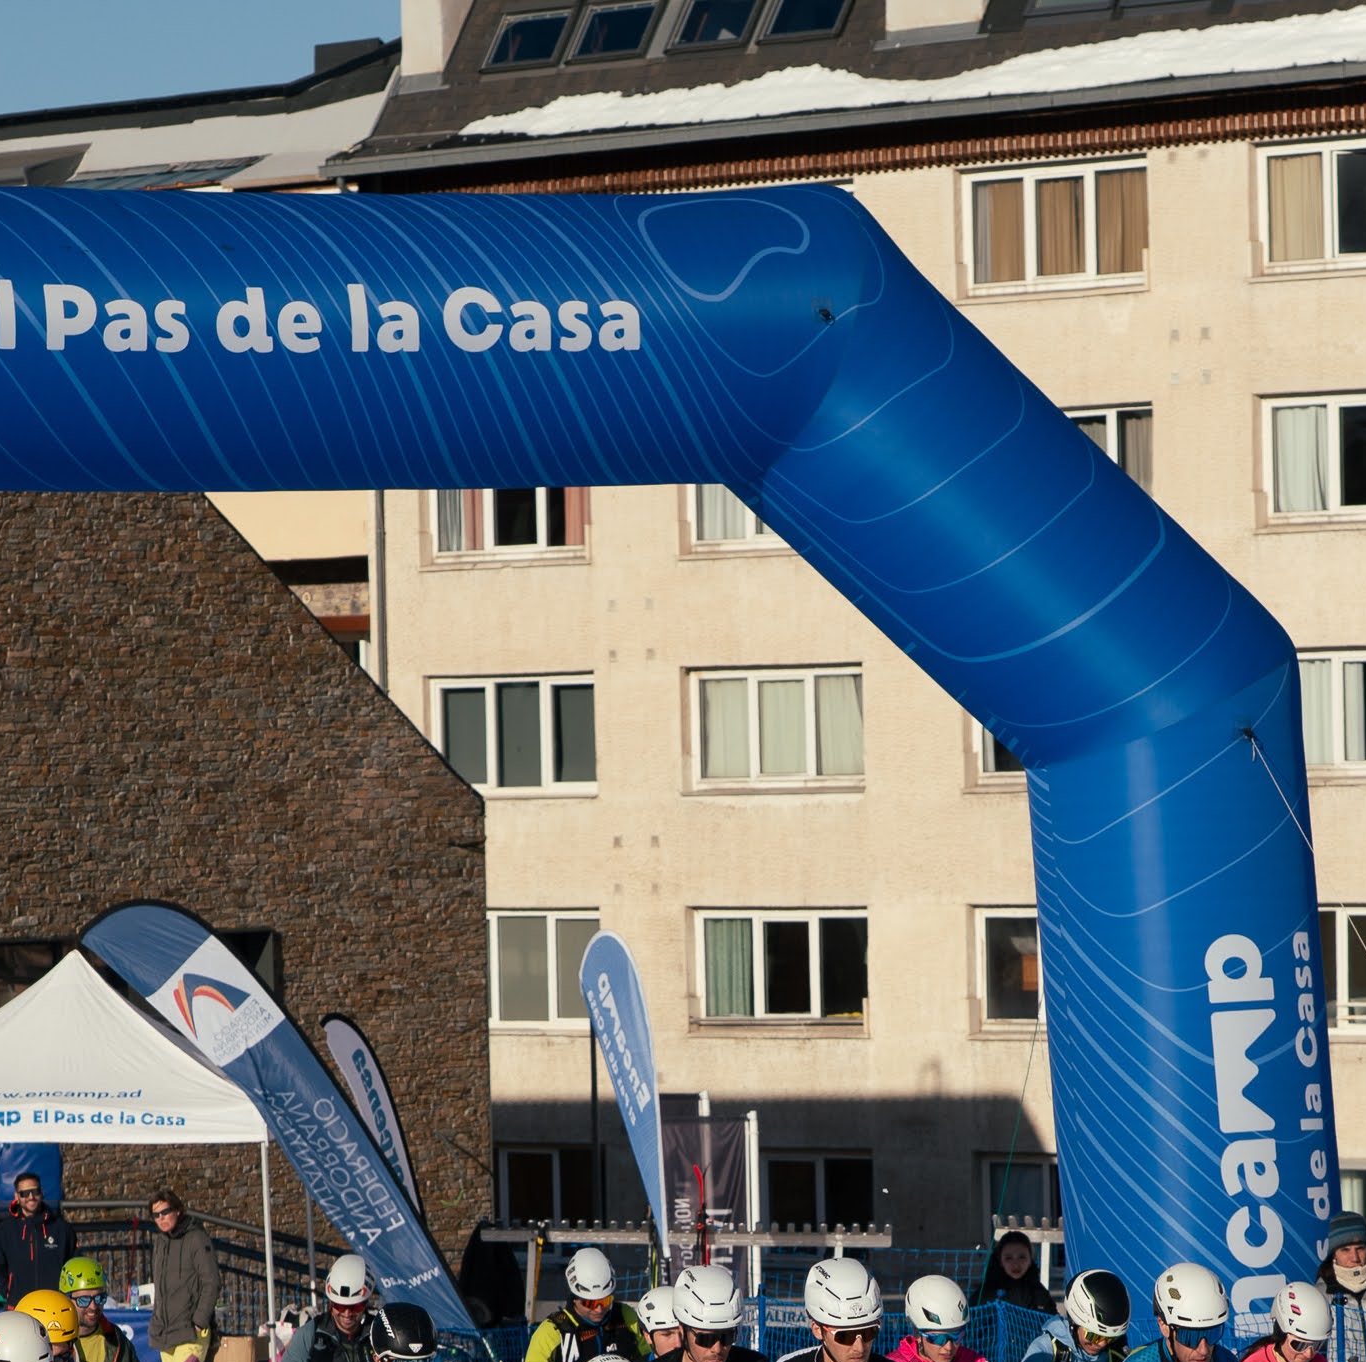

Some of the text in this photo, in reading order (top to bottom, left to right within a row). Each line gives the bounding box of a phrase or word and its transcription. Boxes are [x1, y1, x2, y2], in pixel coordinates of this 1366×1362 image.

[42, 284, 190, 352] Pas
[216, 287, 321, 353] de
[347, 284, 420, 352] la
[442, 286, 641, 353] Casa
[1292, 931, 1318, 1068] Casa
[33, 1109, 49, 1124] El
[55, 1111, 85, 1125] Pas
[90, 1111, 114, 1125] de
[119, 1111, 136, 1125] la
[140, 1113, 186, 1127] Casa
[1205, 934, 1287, 1340] ncamp
[1300, 1083, 1324, 1131] la
[1306, 1149, 1328, 1221] de
